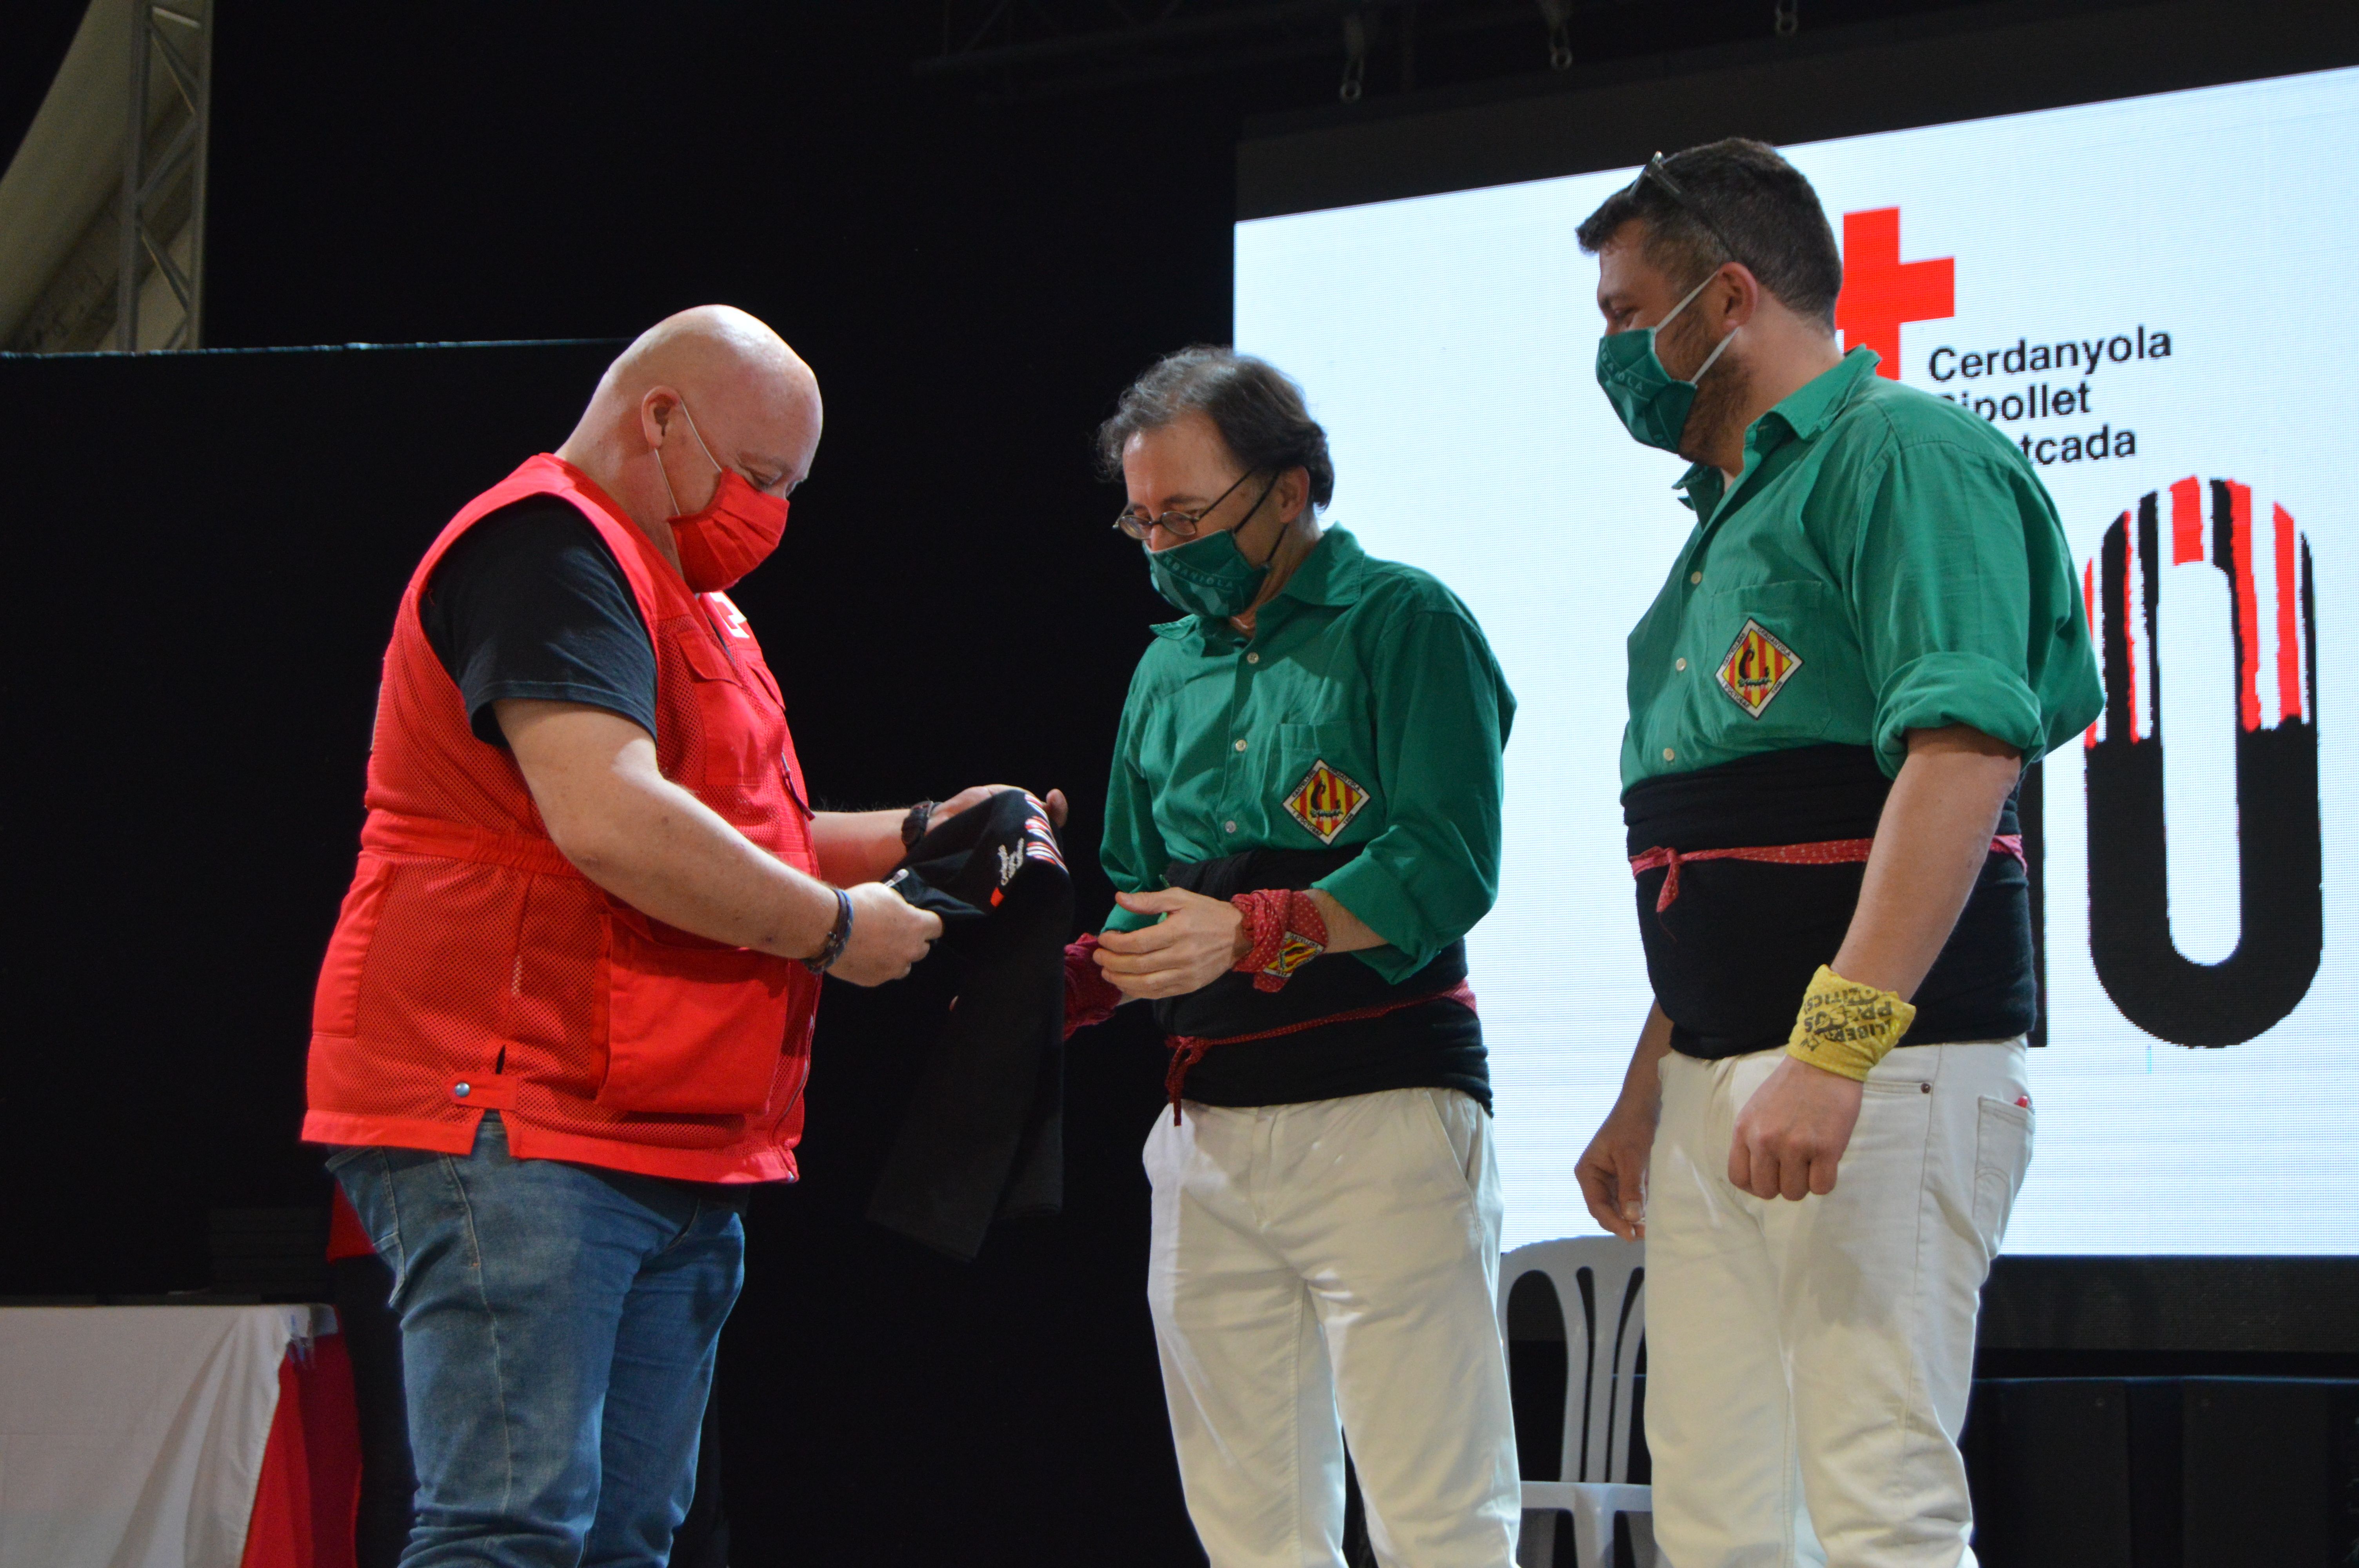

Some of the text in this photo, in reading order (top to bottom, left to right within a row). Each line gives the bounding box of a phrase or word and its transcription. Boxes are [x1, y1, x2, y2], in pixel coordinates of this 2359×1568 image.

[1930, 325, 2172, 381] Cerdanyola
[2020, 424, 2135, 465] tcada
[1757, 628, 1791, 657] CERDANYOLA
